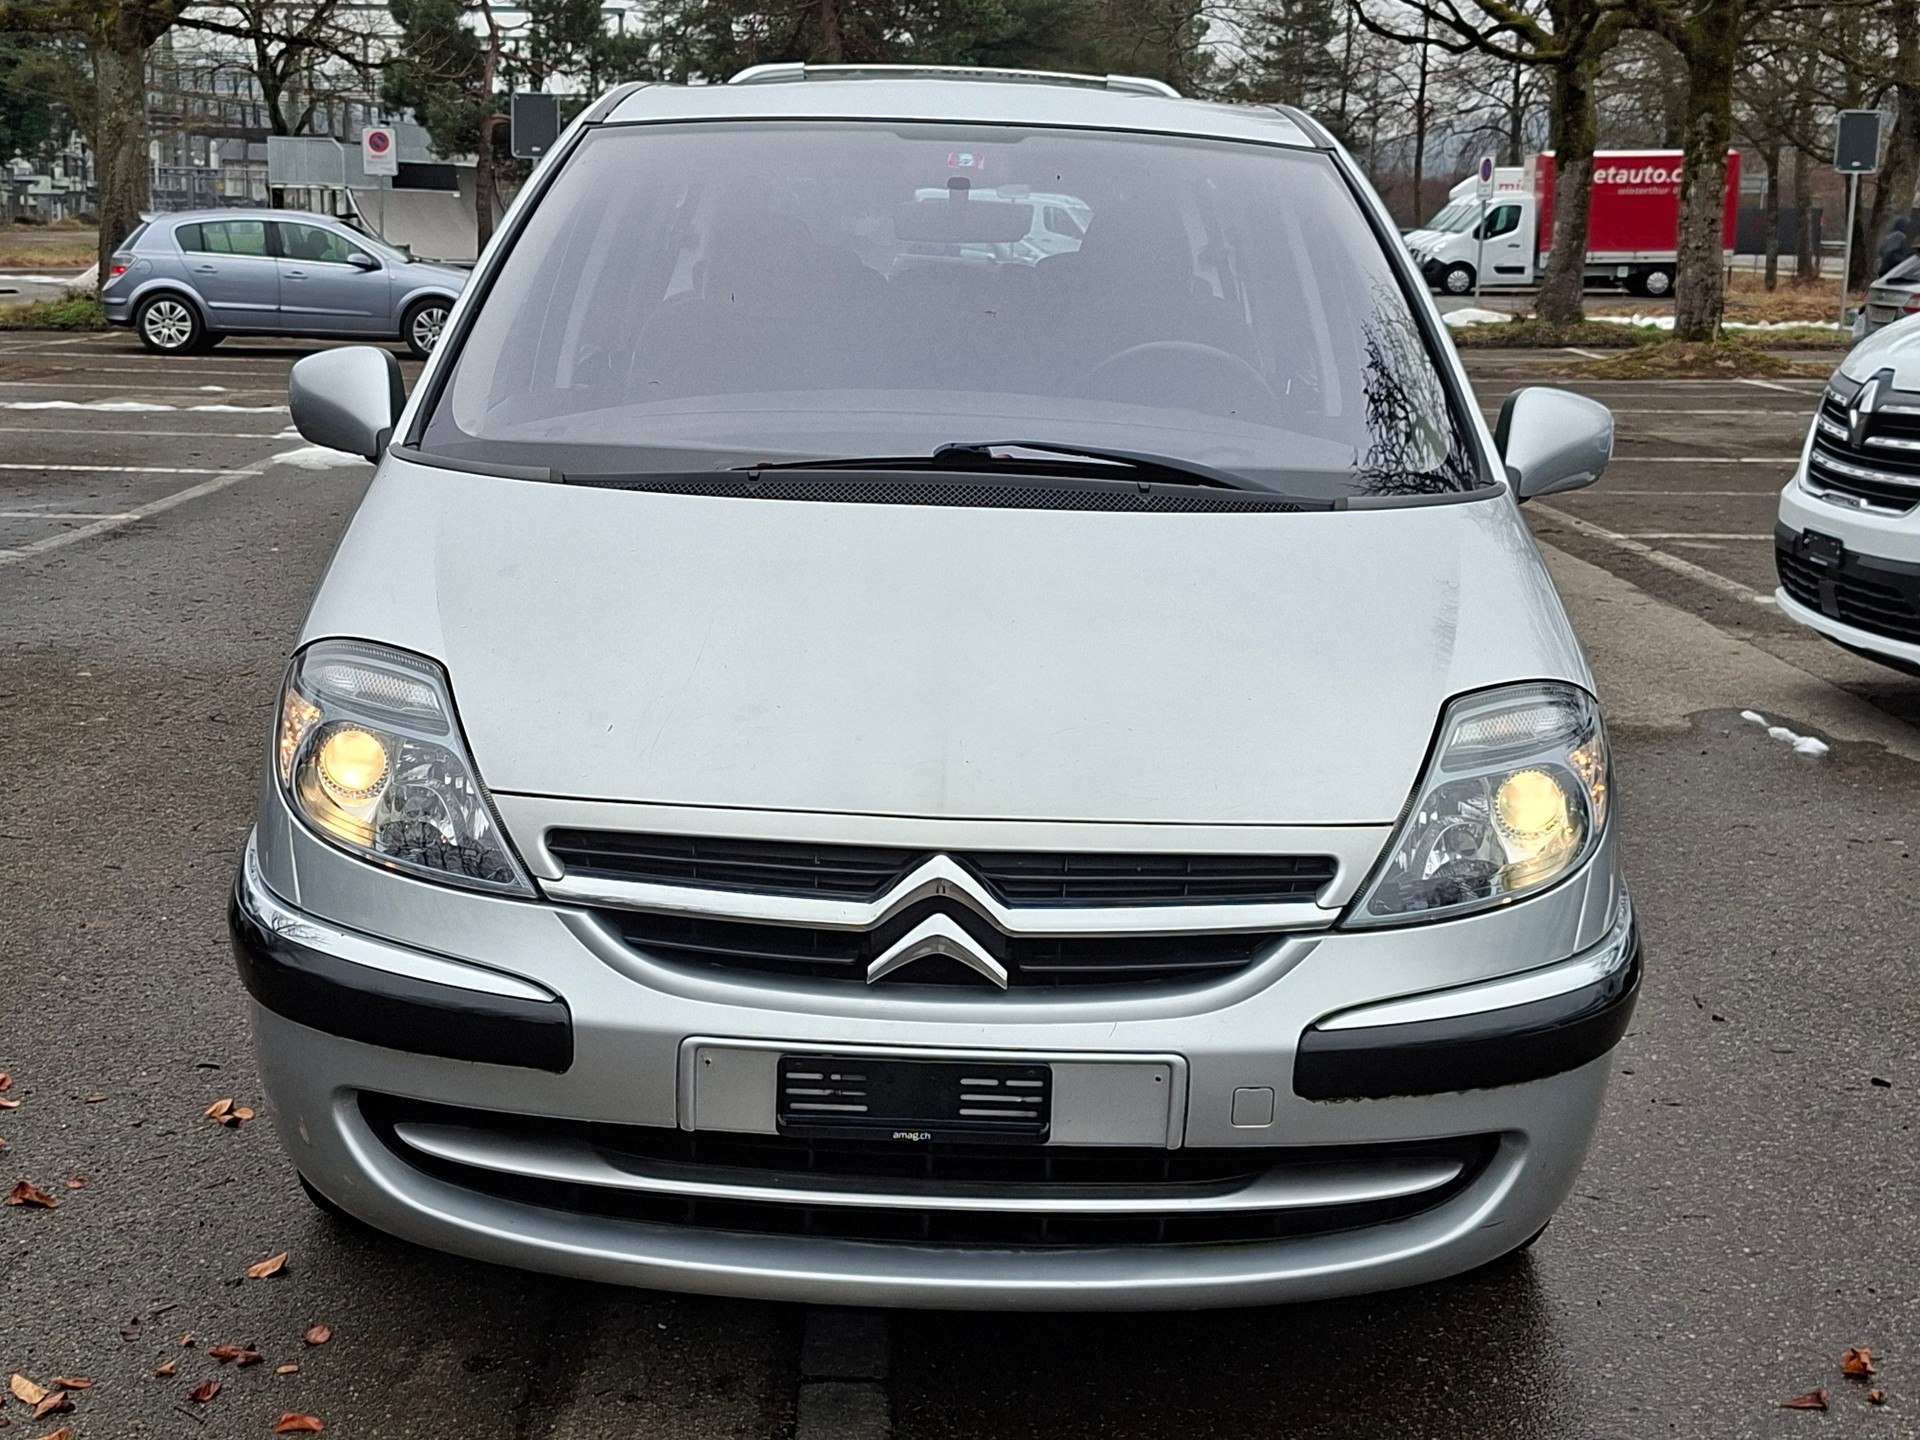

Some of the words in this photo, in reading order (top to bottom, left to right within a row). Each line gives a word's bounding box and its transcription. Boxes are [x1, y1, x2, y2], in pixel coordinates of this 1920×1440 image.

[1594, 165, 1683, 183] etauto.c
[1498, 179, 1522, 191] mi
[893, 1132, 931, 1141] amag.ch
